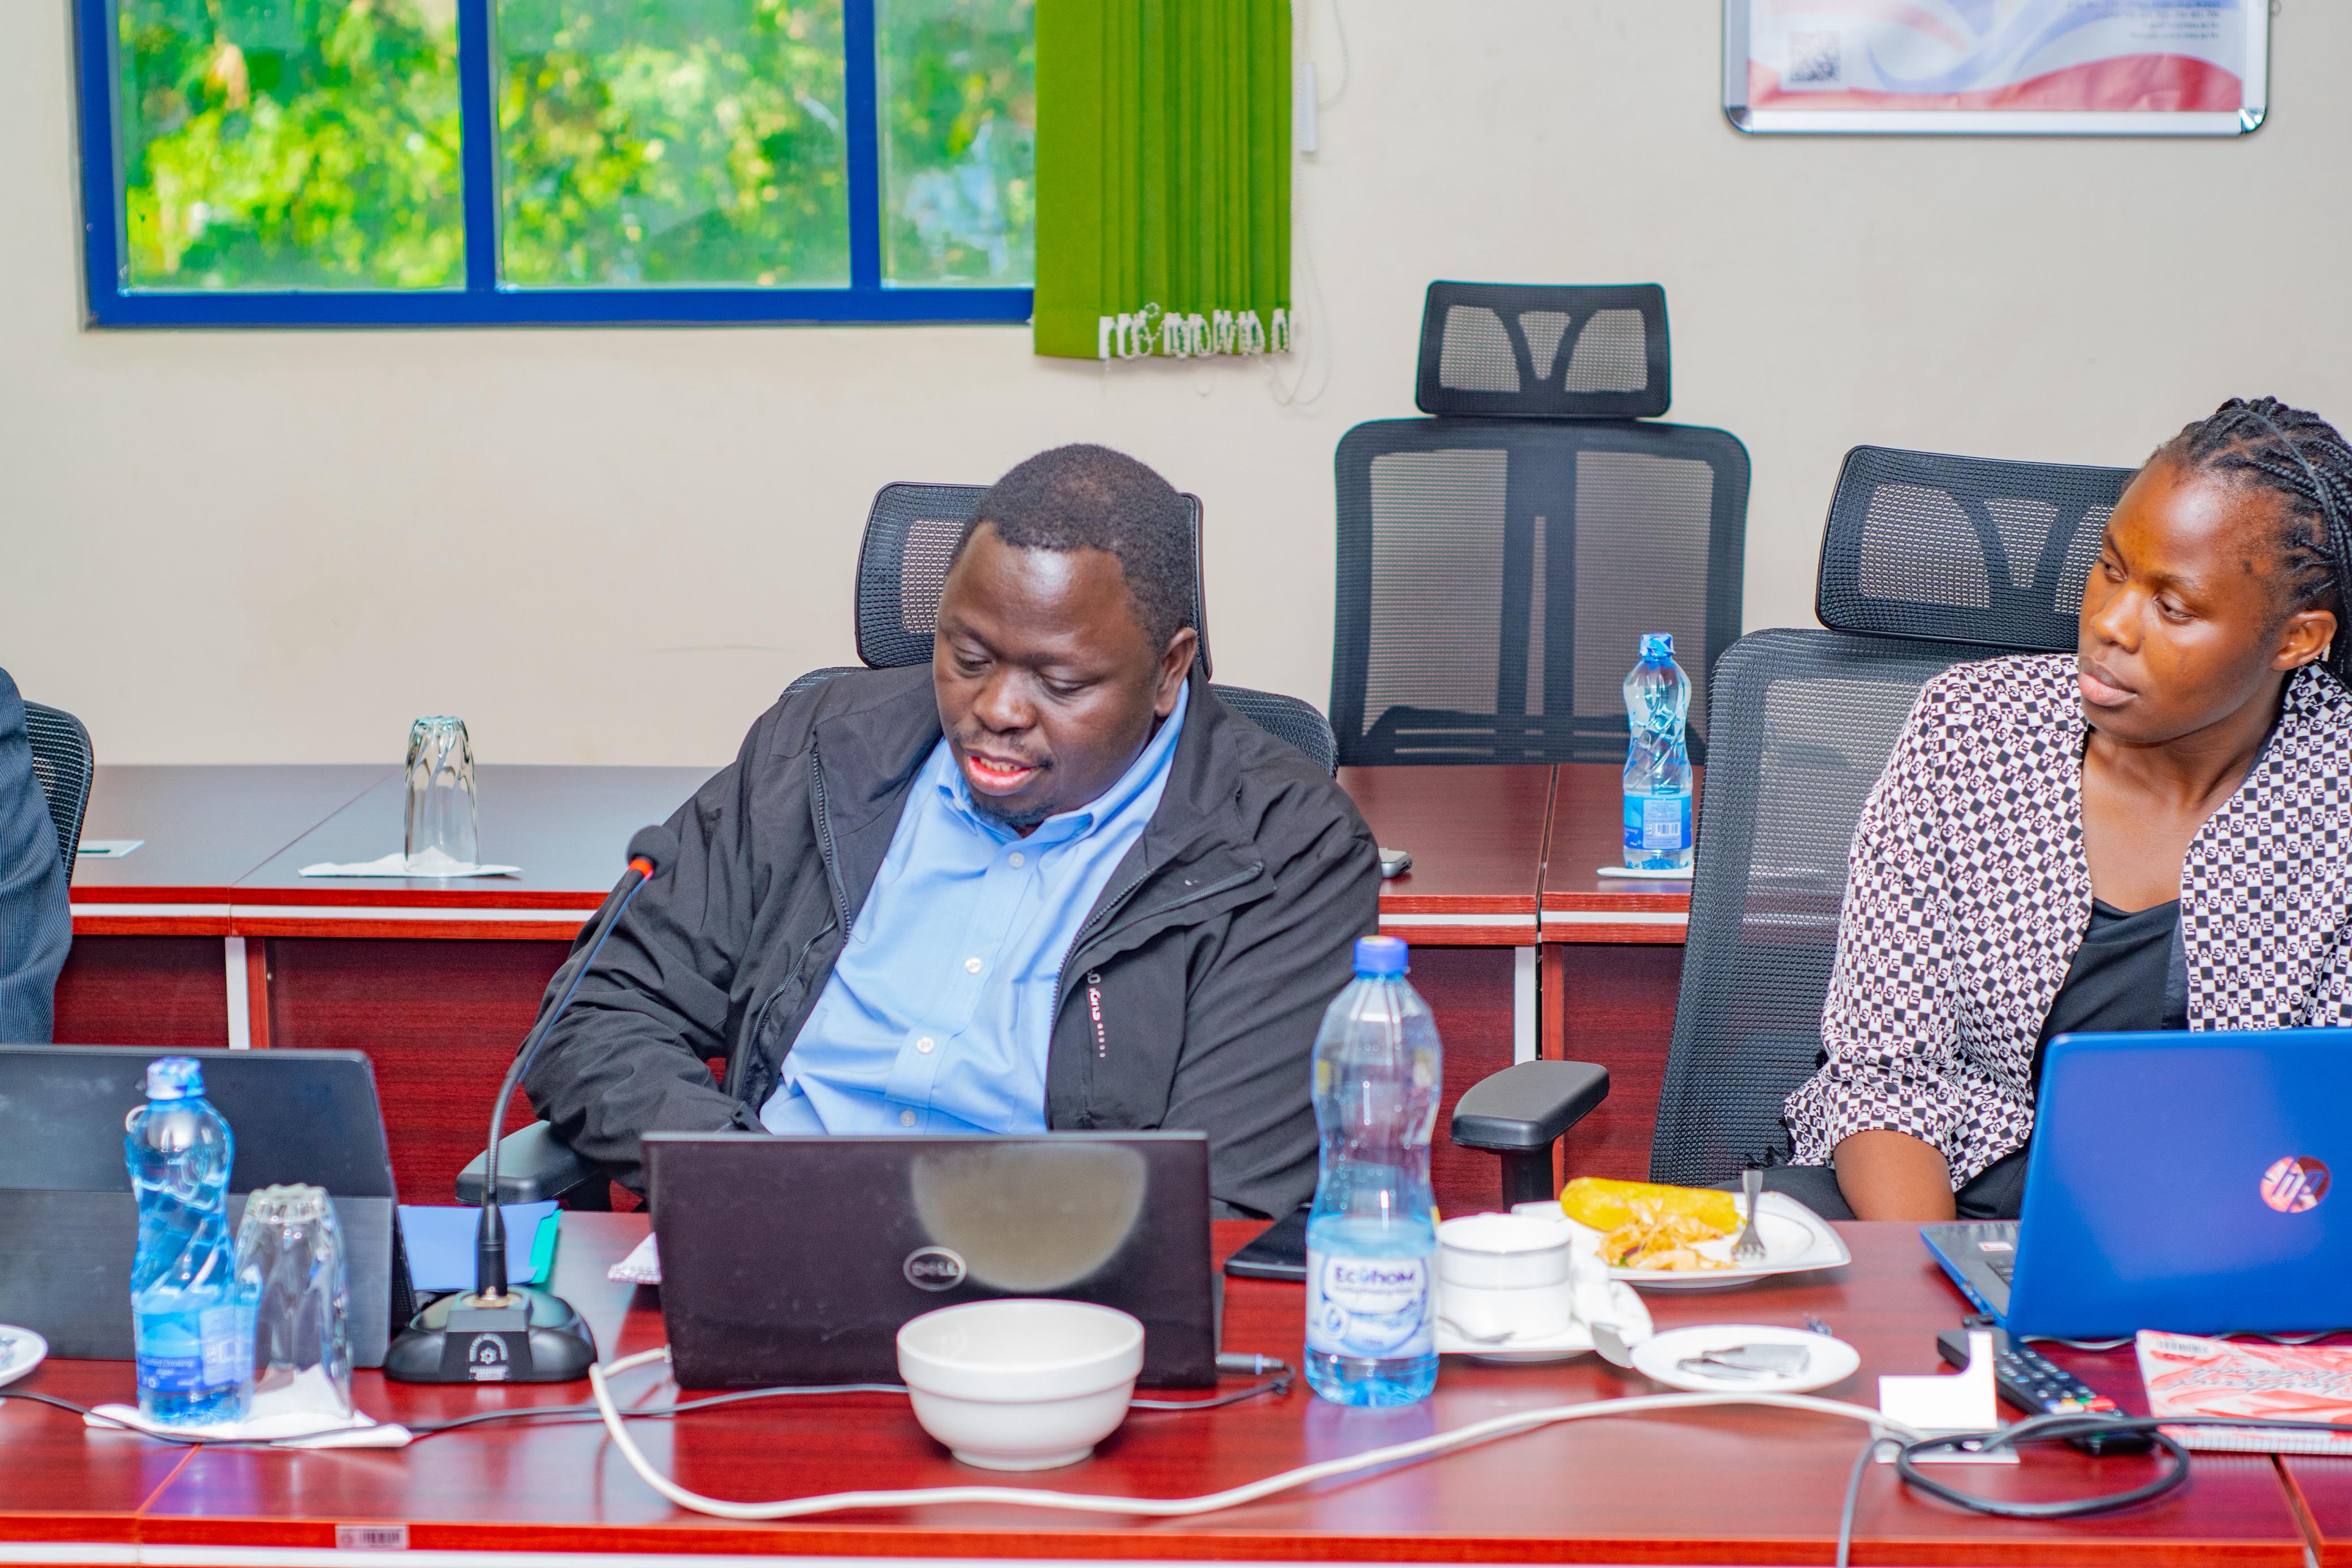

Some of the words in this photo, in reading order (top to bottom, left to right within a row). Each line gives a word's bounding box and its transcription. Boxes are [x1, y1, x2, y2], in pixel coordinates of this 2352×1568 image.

[1967, 666, 2013, 678] ASTE
[2026, 661, 2074, 674] TAST
[1983, 684, 2044, 697] TASTE
[2040, 703, 2082, 716] TAS
[1976, 716, 2030, 754] TASTE
[2286, 720, 2323, 733] TAS
[1953, 728, 1995, 764] ASTE
[2042, 729, 2084, 752] ASTE
[2271, 740, 2321, 756] ASTE
[1899, 750, 1933, 779] TAST
[2041, 752, 2081, 782] TAST
[2285, 757, 2348, 778] TASTE
[1952, 758, 2003, 804] TASTE
[2007, 764, 2061, 804] TASTE
[1901, 786, 1935, 817] TAST
[2260, 786, 2323, 806] TASTE
[2013, 802, 2066, 841] TASTE
[2206, 817, 2271, 834] TASTE
[2286, 811, 2349, 828] TASTE
[1935, 816, 1975, 853] ASTE
[1979, 814, 2033, 855] TASTE
[1880, 837, 1931, 876] TASTE
[2192, 845, 2245, 858] ASTE
[2261, 839, 2324, 855] TASTE
[1986, 851, 2039, 893] TASTE
[2043, 852, 2091, 892] TASTE
[2208, 868, 2273, 884] TASTE
[2289, 861, 2345, 878] TASTE
[1951, 863, 2005, 904] TASTE
[1862, 895, 1909, 916] TASTE
[2183, 895, 2247, 909] TASTE
[2263, 890, 2323, 904] TASTE
[1958, 901, 2010, 943] TASTE
[2013, 903, 2061, 943] TASTE
[2211, 918, 2273, 934] TASTE
[2289, 912, 2345, 930] TASTE
[1874, 926, 1929, 948] TASTE
[2187, 946, 2249, 960] TASTE
[2263, 940, 2321, 956] TASTE
[1853, 950, 1900, 972] TASTE
[2018, 940, 2064, 982] TASTE
[1916, 963, 1956, 982] TAST
[1985, 954, 2033, 993] TASTE
[2216, 969, 2274, 986] TASTE
[2289, 964, 2322, 980] TAS
[1866, 980, 1919, 1004] TASTE
[2319, 979, 2352, 998] AST
[1936, 994, 1959, 1012] TAS
[2191, 997, 2250, 1012] TASTE
[2266, 993, 2302, 1007] TAS
[1845, 1003, 1893, 1026] TASTE
[1992, 990, 2042, 1032] TASTE
[2307, 1005, 2337, 1023] STE
[1906, 1018, 1952, 1039] TASTE
[1925, 1050, 1948, 1064] TAS
[1850, 1105, 1911, 1120] TASTE
[163, 1358, 194, 1368] Drinking
